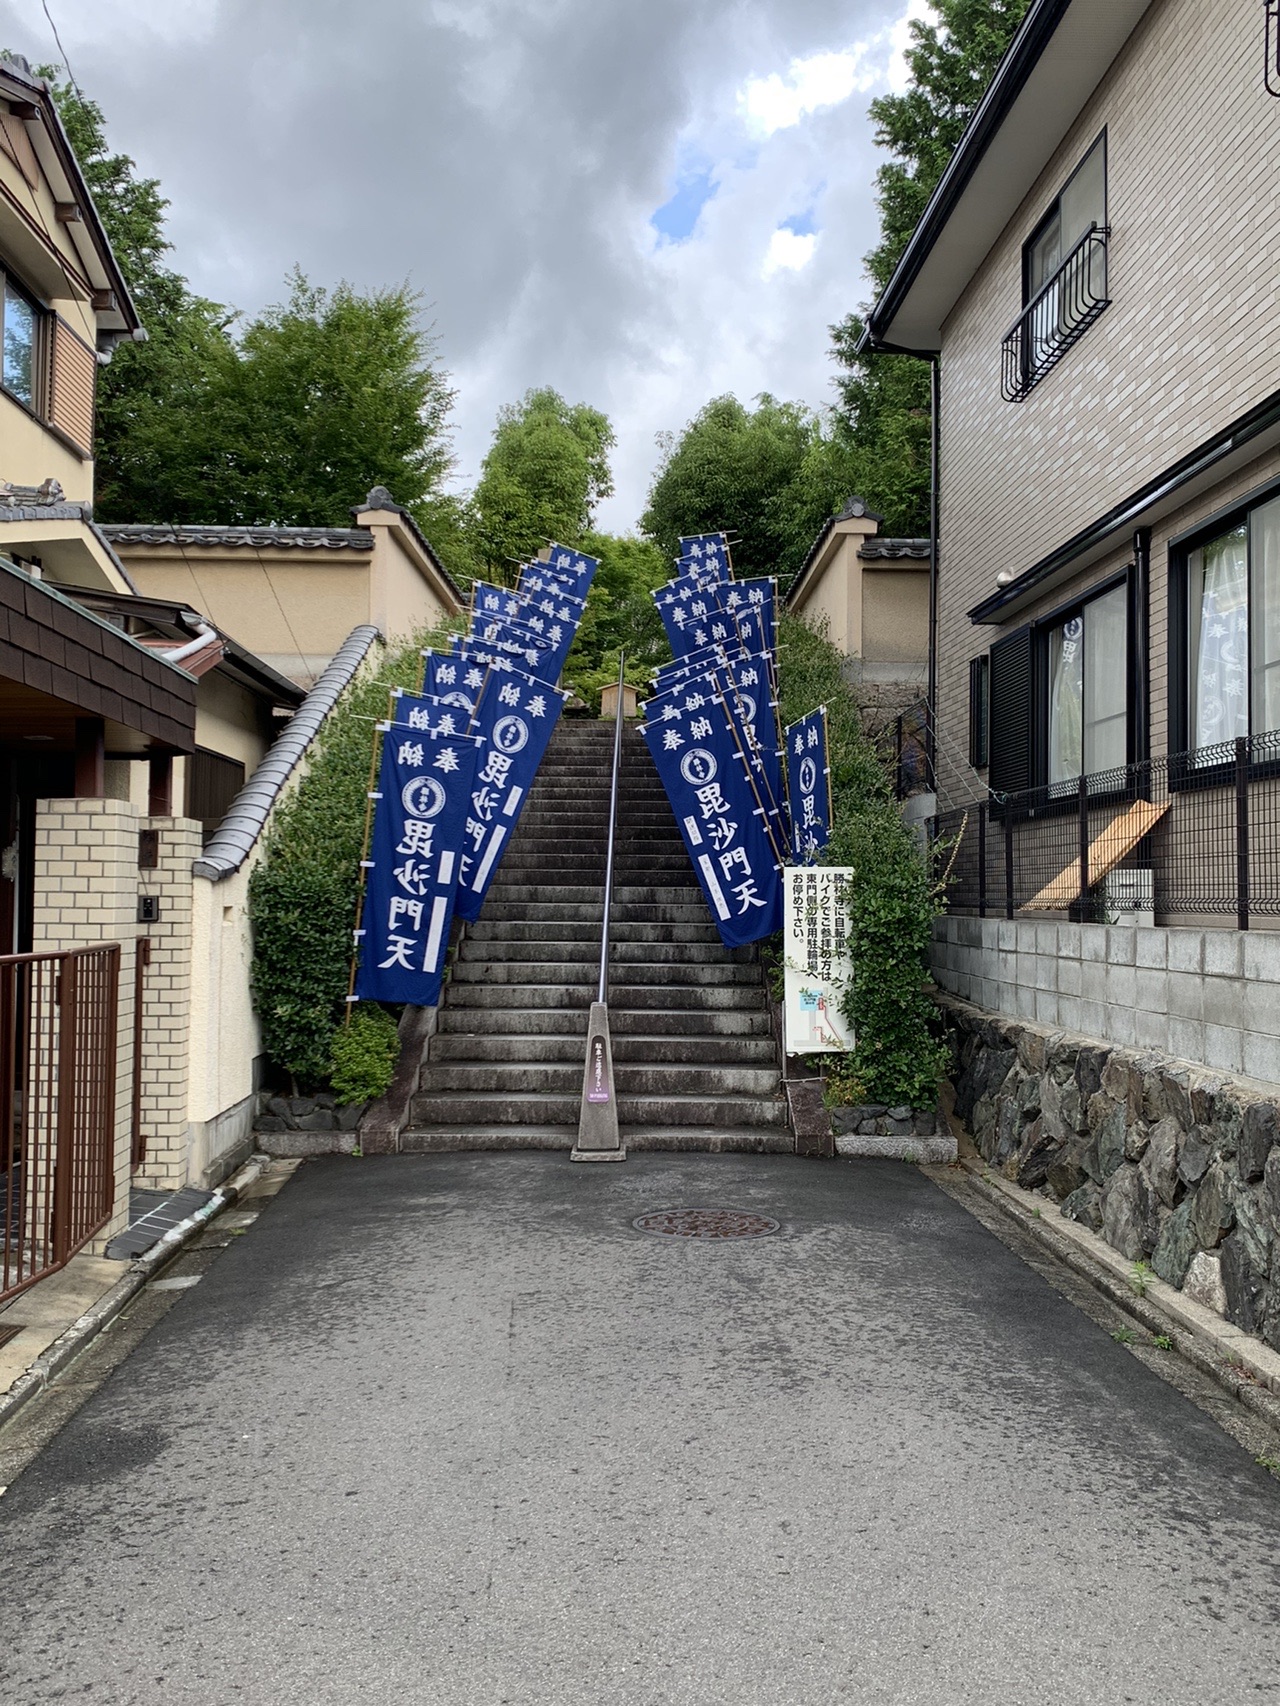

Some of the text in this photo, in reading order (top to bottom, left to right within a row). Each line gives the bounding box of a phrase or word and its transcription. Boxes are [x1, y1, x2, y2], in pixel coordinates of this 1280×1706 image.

[672, 600, 707, 622] 奉納
[694, 622, 727, 647] 奉納
[662, 716, 713, 751] 奉納
[794, 726, 818, 756] 奉納
[695, 782, 768, 916] 毘沙門天
[793, 873, 804, 944] お停め下さい。
[820, 873, 832, 982] バイクでご参拝の方は
